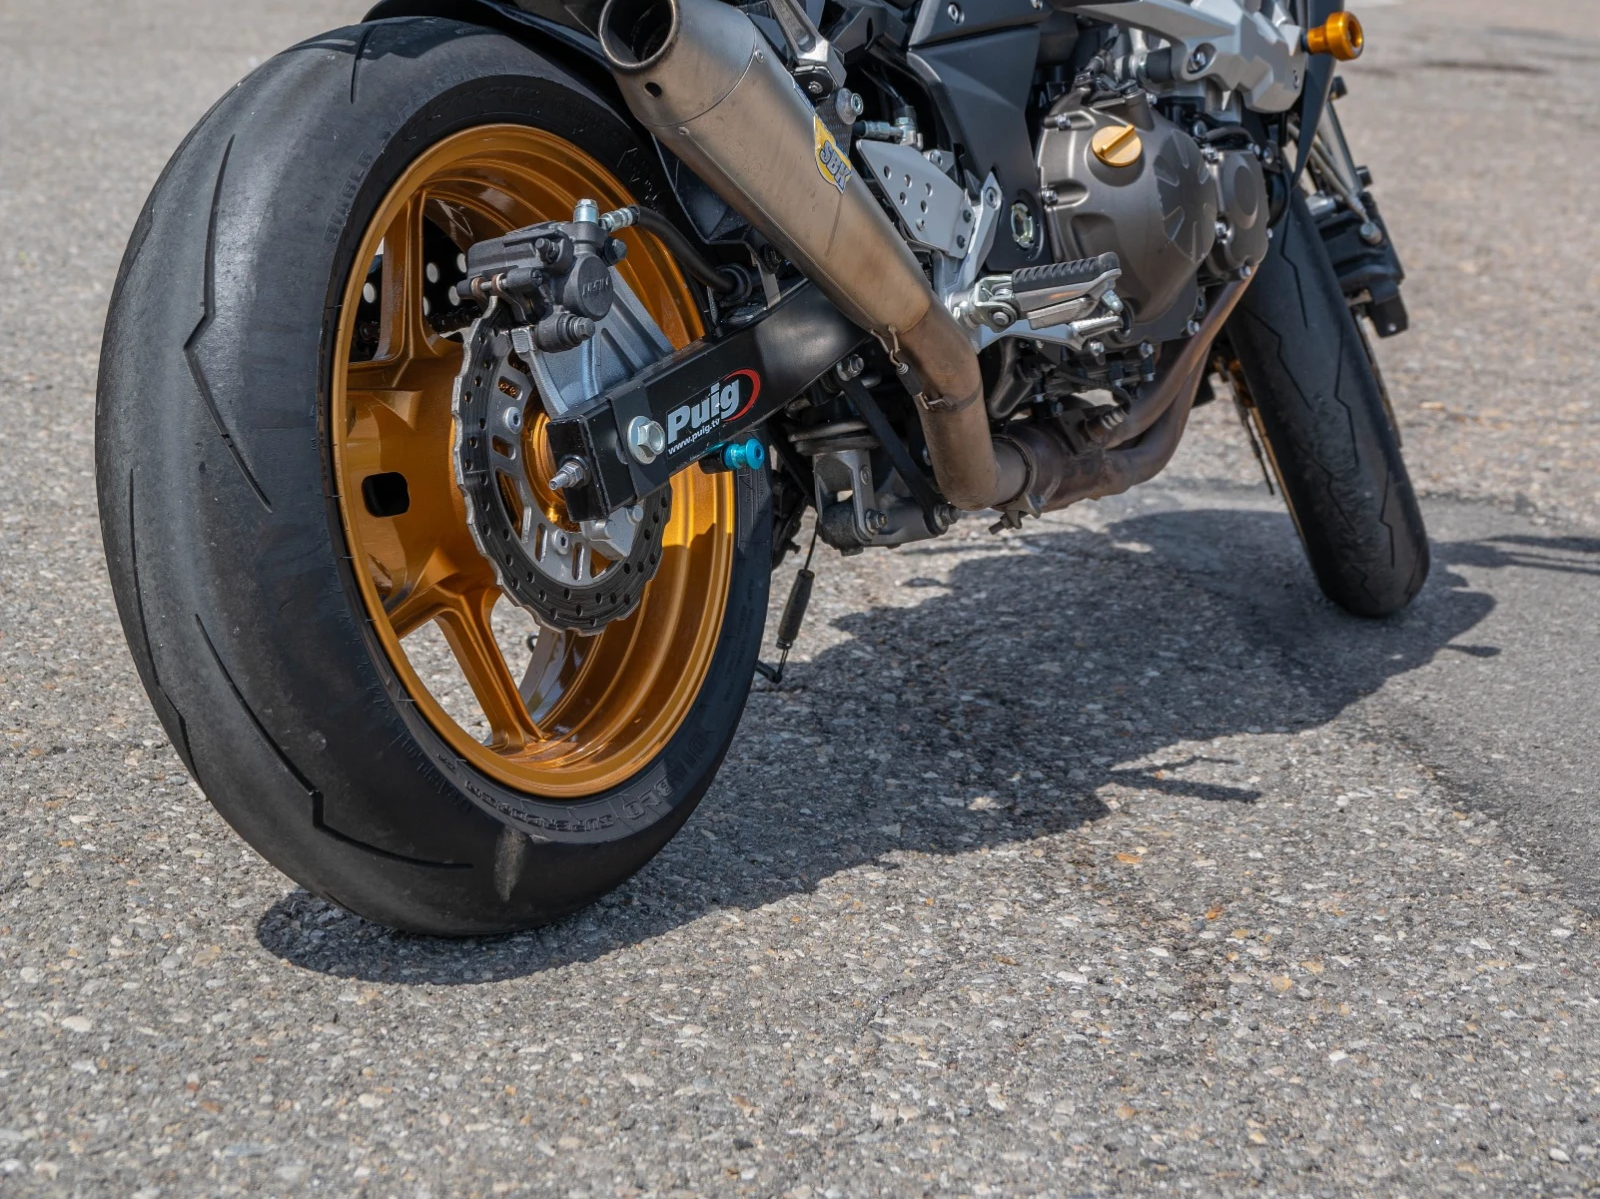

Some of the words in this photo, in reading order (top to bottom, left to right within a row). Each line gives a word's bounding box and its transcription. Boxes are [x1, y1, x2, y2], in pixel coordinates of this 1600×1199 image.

[820, 139, 852, 192] SBK
[667, 378, 741, 445] Puig
[667, 417, 721, 456] www.puig.tv
